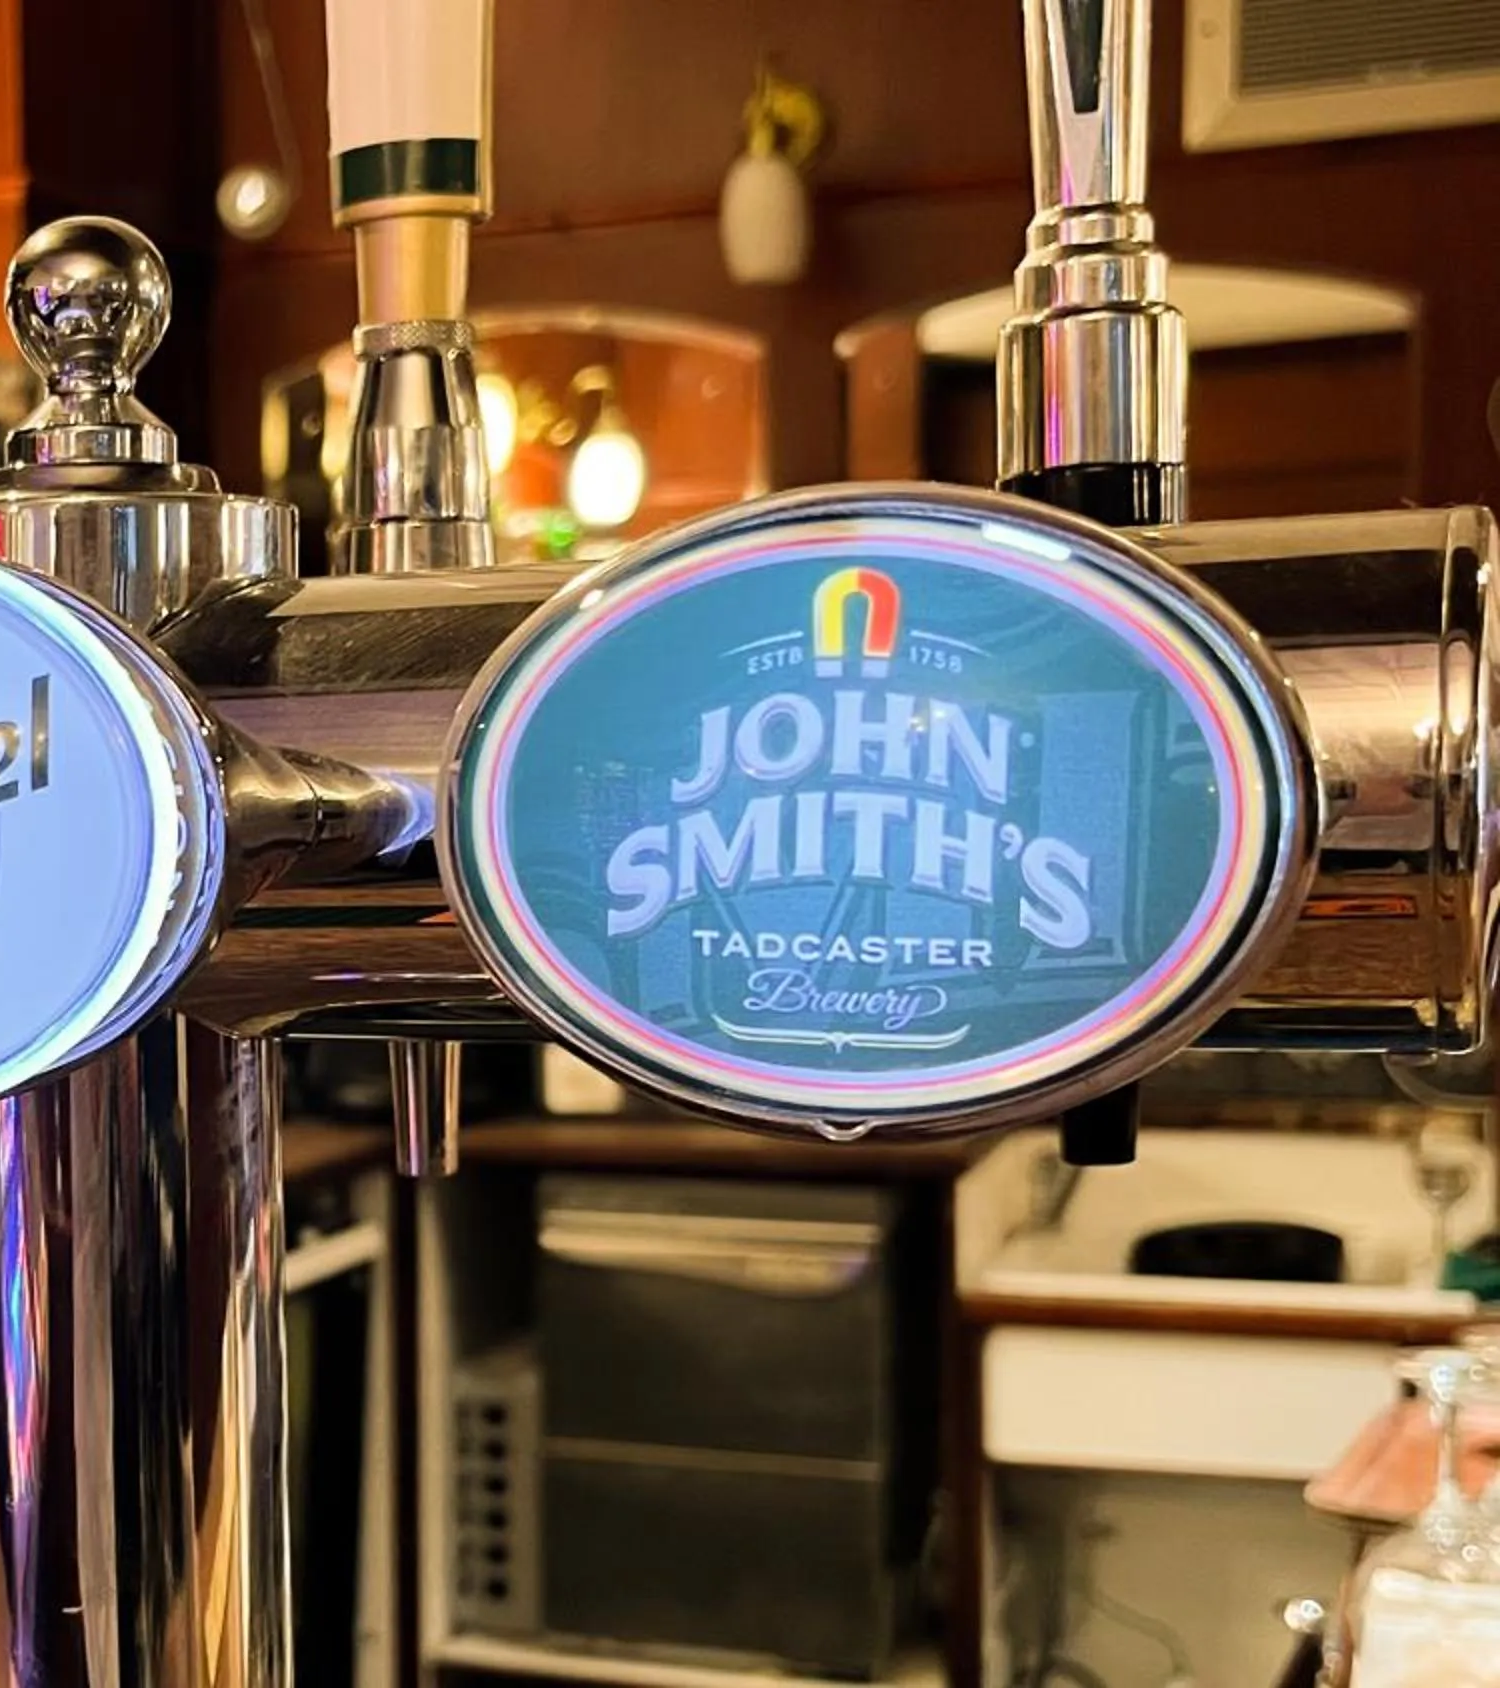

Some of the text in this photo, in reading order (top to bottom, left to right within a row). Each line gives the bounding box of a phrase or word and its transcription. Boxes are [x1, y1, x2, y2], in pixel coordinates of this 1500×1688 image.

[909, 645, 963, 674] 1758
[670, 689, 1013, 805] JOHN
[605, 791, 1092, 950] SMITH'S
[692, 929, 993, 967] TADCASTER
[742, 966, 948, 1031] Brewery
